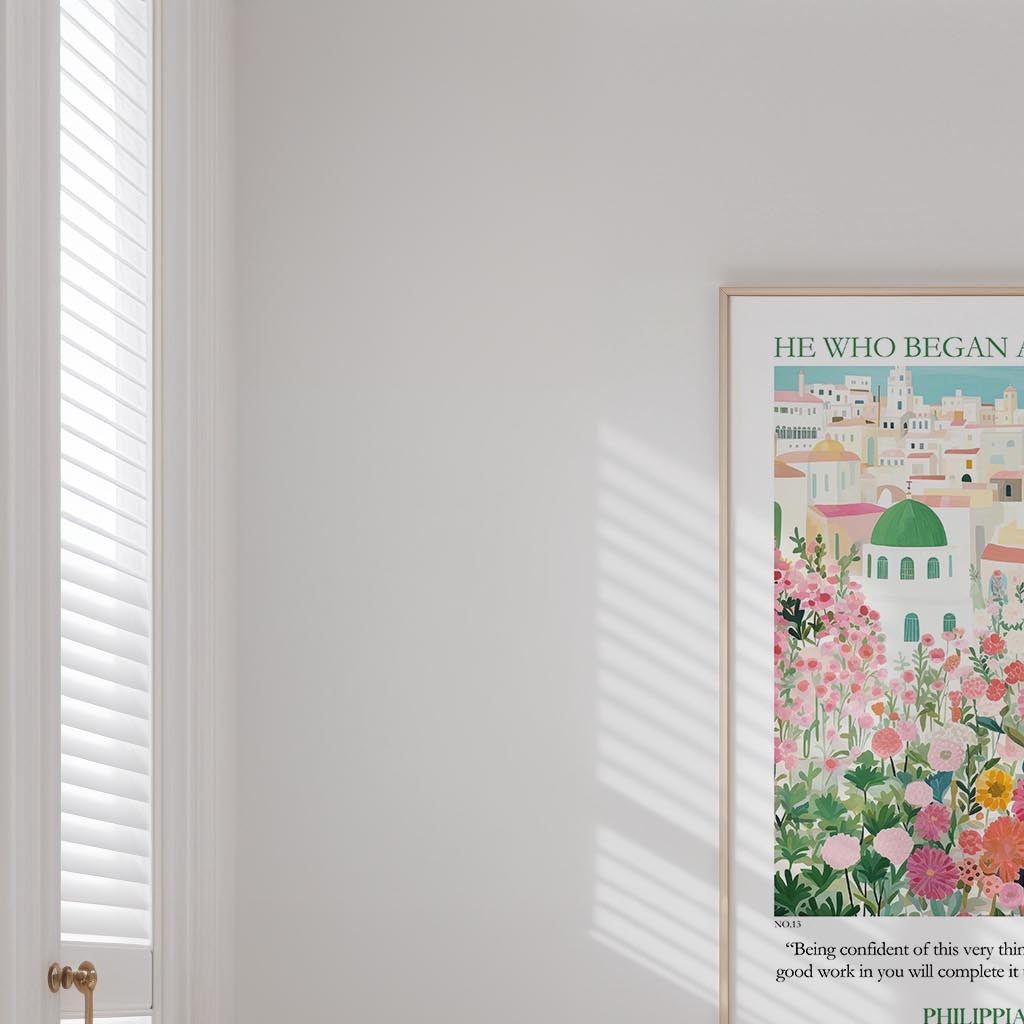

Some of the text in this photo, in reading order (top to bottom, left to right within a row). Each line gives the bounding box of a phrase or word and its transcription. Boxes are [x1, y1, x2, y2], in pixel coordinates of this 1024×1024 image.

[774, 337, 816, 358] HE
[823, 337, 896, 359] WHO
[904, 336, 1008, 358] BEGAN
[785, 941, 837, 960] “Being
[839, 941, 910, 956] confident
[912, 941, 931, 956] of
[933, 941, 959, 956] this
[963, 946, 994, 960] very
[775, 963, 814, 983] good
[817, 963, 855, 978] work
[858, 963, 874, 978] in
[877, 967, 905, 983] you
[908, 963, 934, 978] will
[937, 963, 1005, 983] complete
[1008, 963, 1019, 978] it
